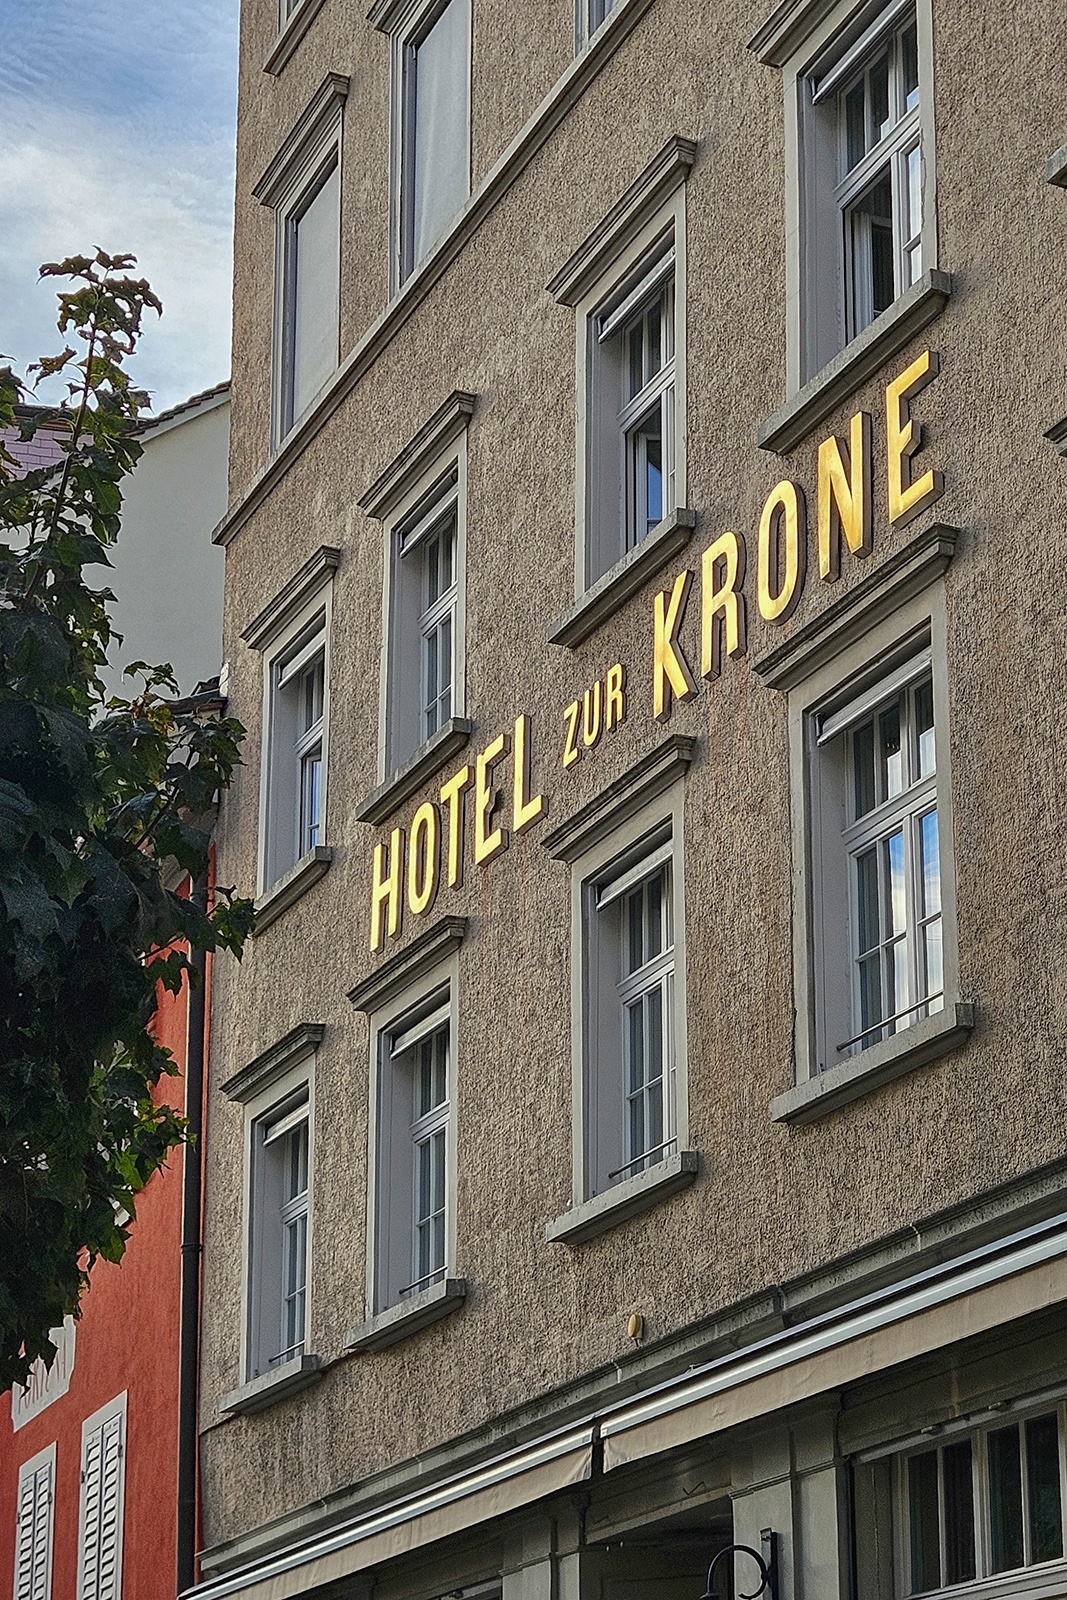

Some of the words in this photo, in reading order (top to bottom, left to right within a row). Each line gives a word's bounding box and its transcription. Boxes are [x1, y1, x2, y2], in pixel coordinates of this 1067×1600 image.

[370, 713, 545, 952] HOTEL
[563, 663, 625, 769] ZUR
[653, 349, 938, 721] KRONE
